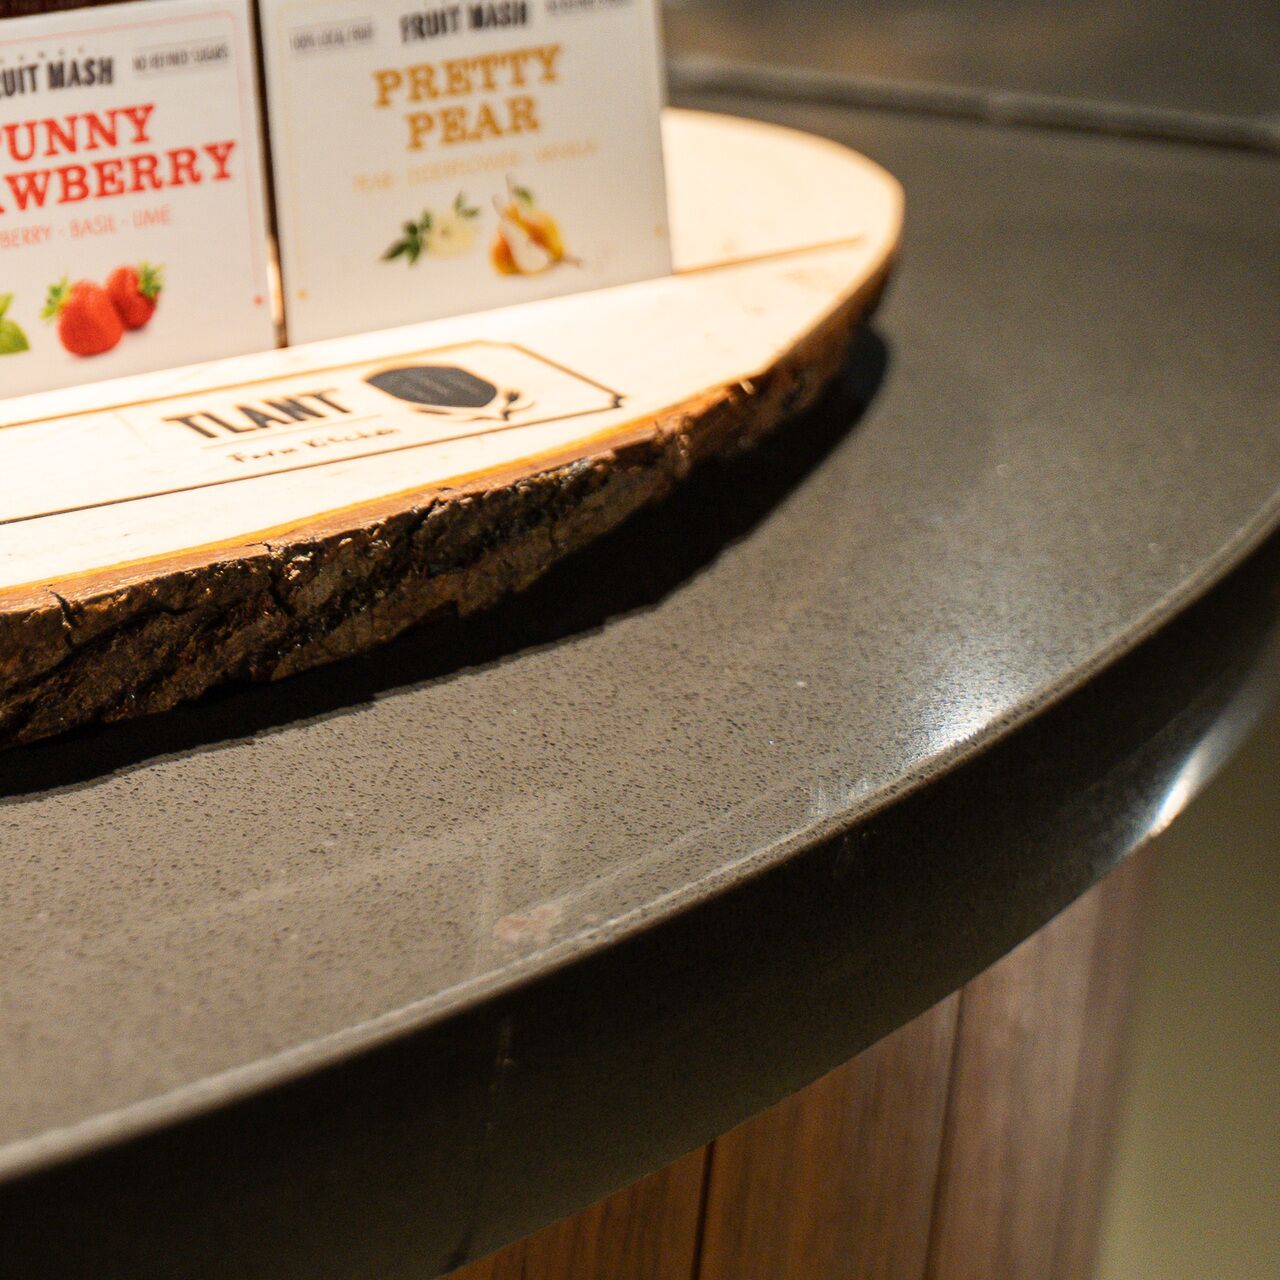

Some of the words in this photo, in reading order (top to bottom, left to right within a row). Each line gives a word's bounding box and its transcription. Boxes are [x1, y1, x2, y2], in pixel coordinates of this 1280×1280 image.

[398, 3, 462, 45] FRUIT
[46, 56, 116, 92] MASH
[371, 42, 563, 109] PRETTY
[403, 94, 540, 152] PEAR
[69, 215, 117, 240] BASIL
[131, 204, 172, 229] LIME
[160, 386, 353, 439] TLANT
